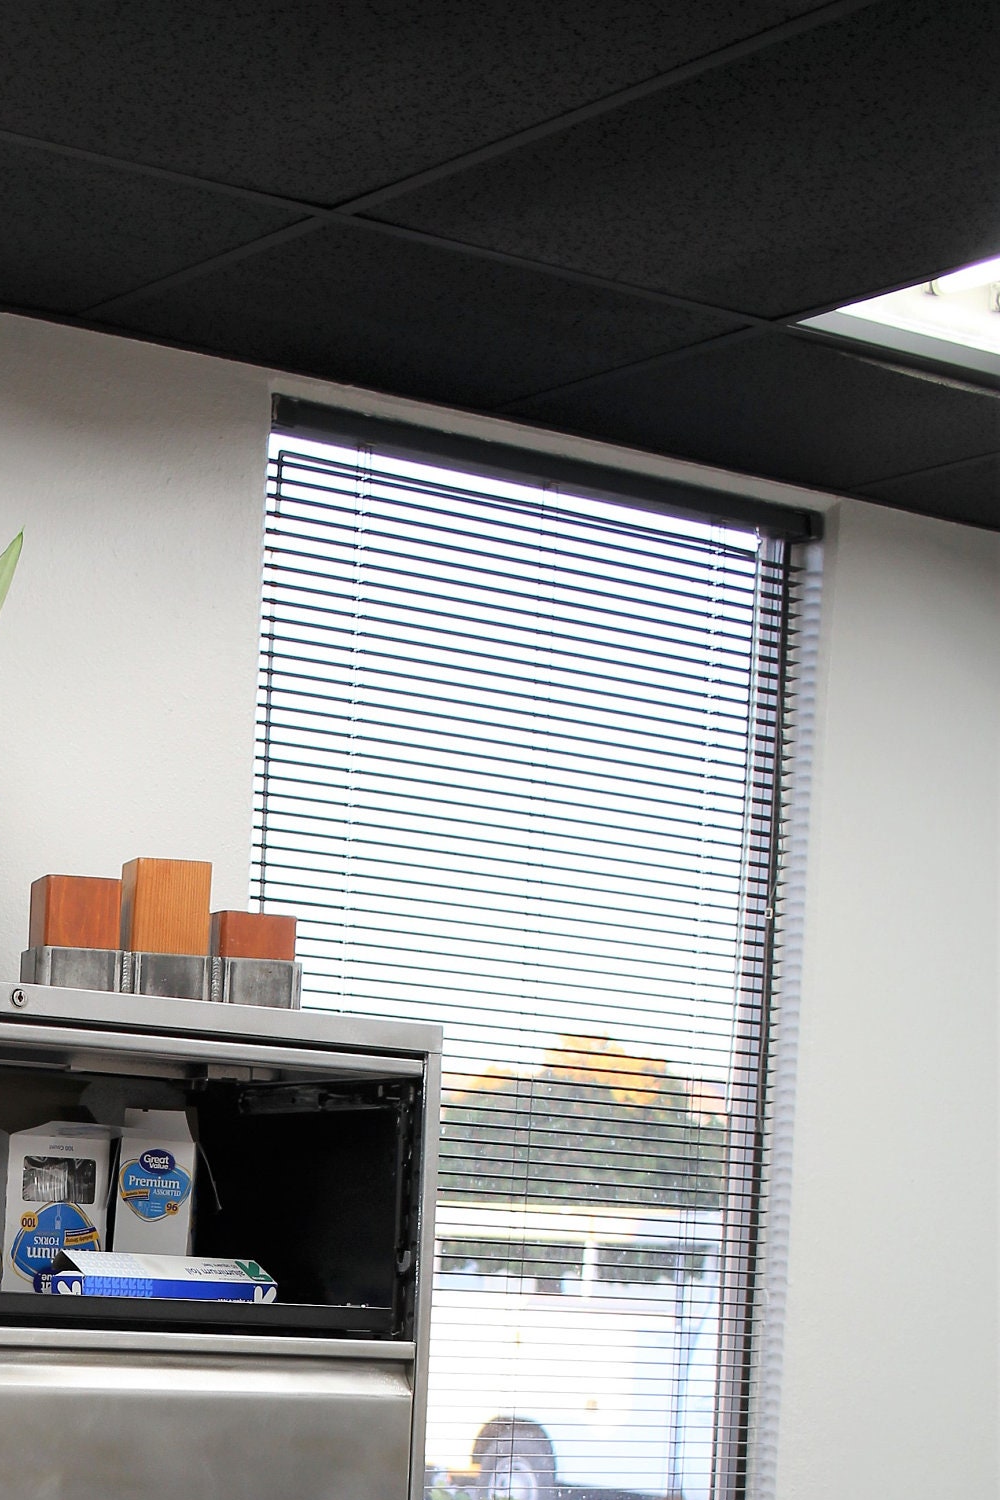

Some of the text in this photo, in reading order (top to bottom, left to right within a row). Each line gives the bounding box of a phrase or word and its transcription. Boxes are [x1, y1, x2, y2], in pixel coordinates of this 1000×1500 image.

[143, 1154, 169, 1165] Great
[128, 1175, 180, 1190] Premium
[152, 1188, 181, 1197] ASSORTED
[166, 1202, 178, 1212] 96
[21, 1217, 36, 1228] 100
[33, 1236, 60, 1246] FORKS
